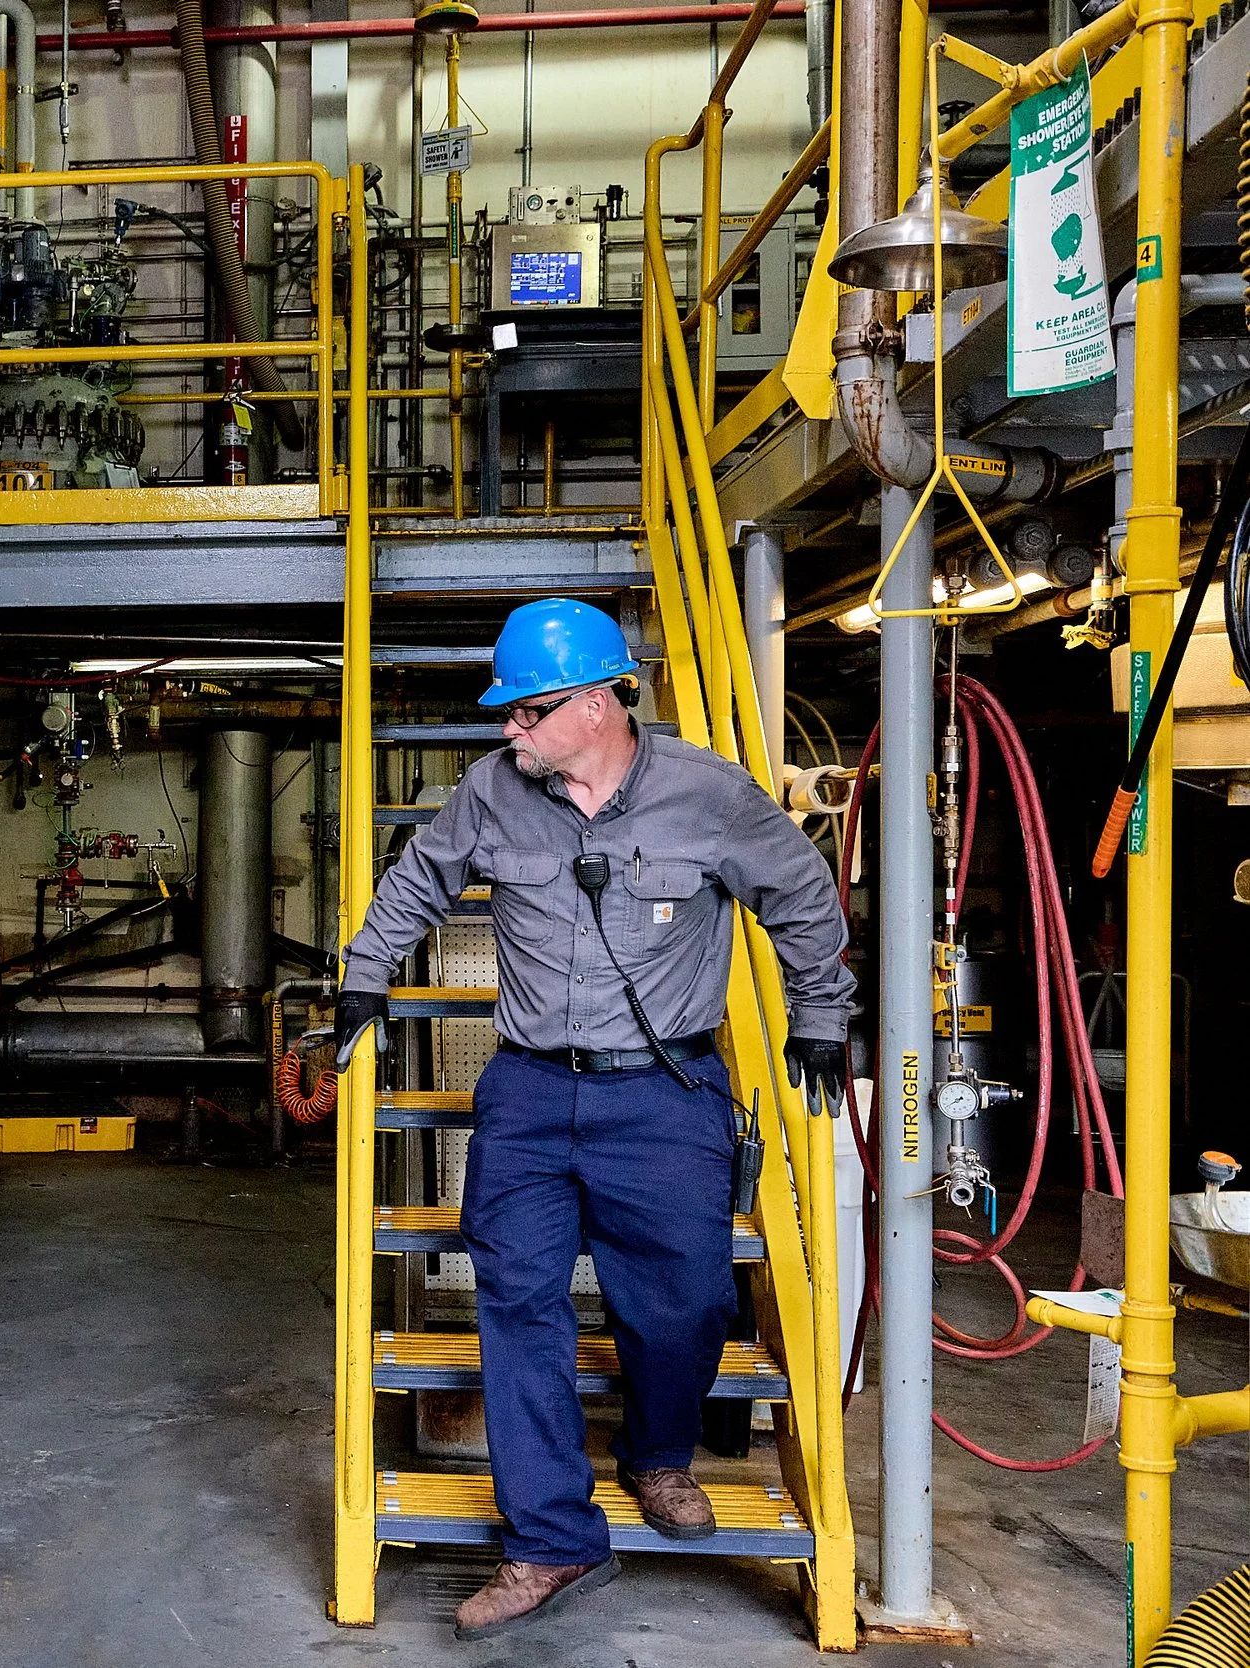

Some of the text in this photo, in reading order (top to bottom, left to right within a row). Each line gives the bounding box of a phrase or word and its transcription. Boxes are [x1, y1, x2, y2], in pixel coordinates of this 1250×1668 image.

[1051, 118, 1086, 153] STATION
[231, 129, 241, 185] Fie
[425, 153, 448, 164] SHOWER
[426, 144, 447, 155] SAFETY
[1140, 244, 1151, 262] 4
[1035, 315, 1068, 331] KEEP
[1071, 305, 1096, 323] AREA
[1053, 326, 1070, 336] TEST
[1072, 324, 1083, 332] ALL
[1056, 327, 1092, 342] EQUIPMENT
[1064, 339, 1105, 359] GUARDIAN
[1065, 346, 1108, 367] EQUIPMENT
[949, 457, 977, 469] ENT
[1133, 654, 1144, 741] SAFE
[273, 1005, 282, 1030] Line
[903, 1055, 919, 1158] NITROGEN
